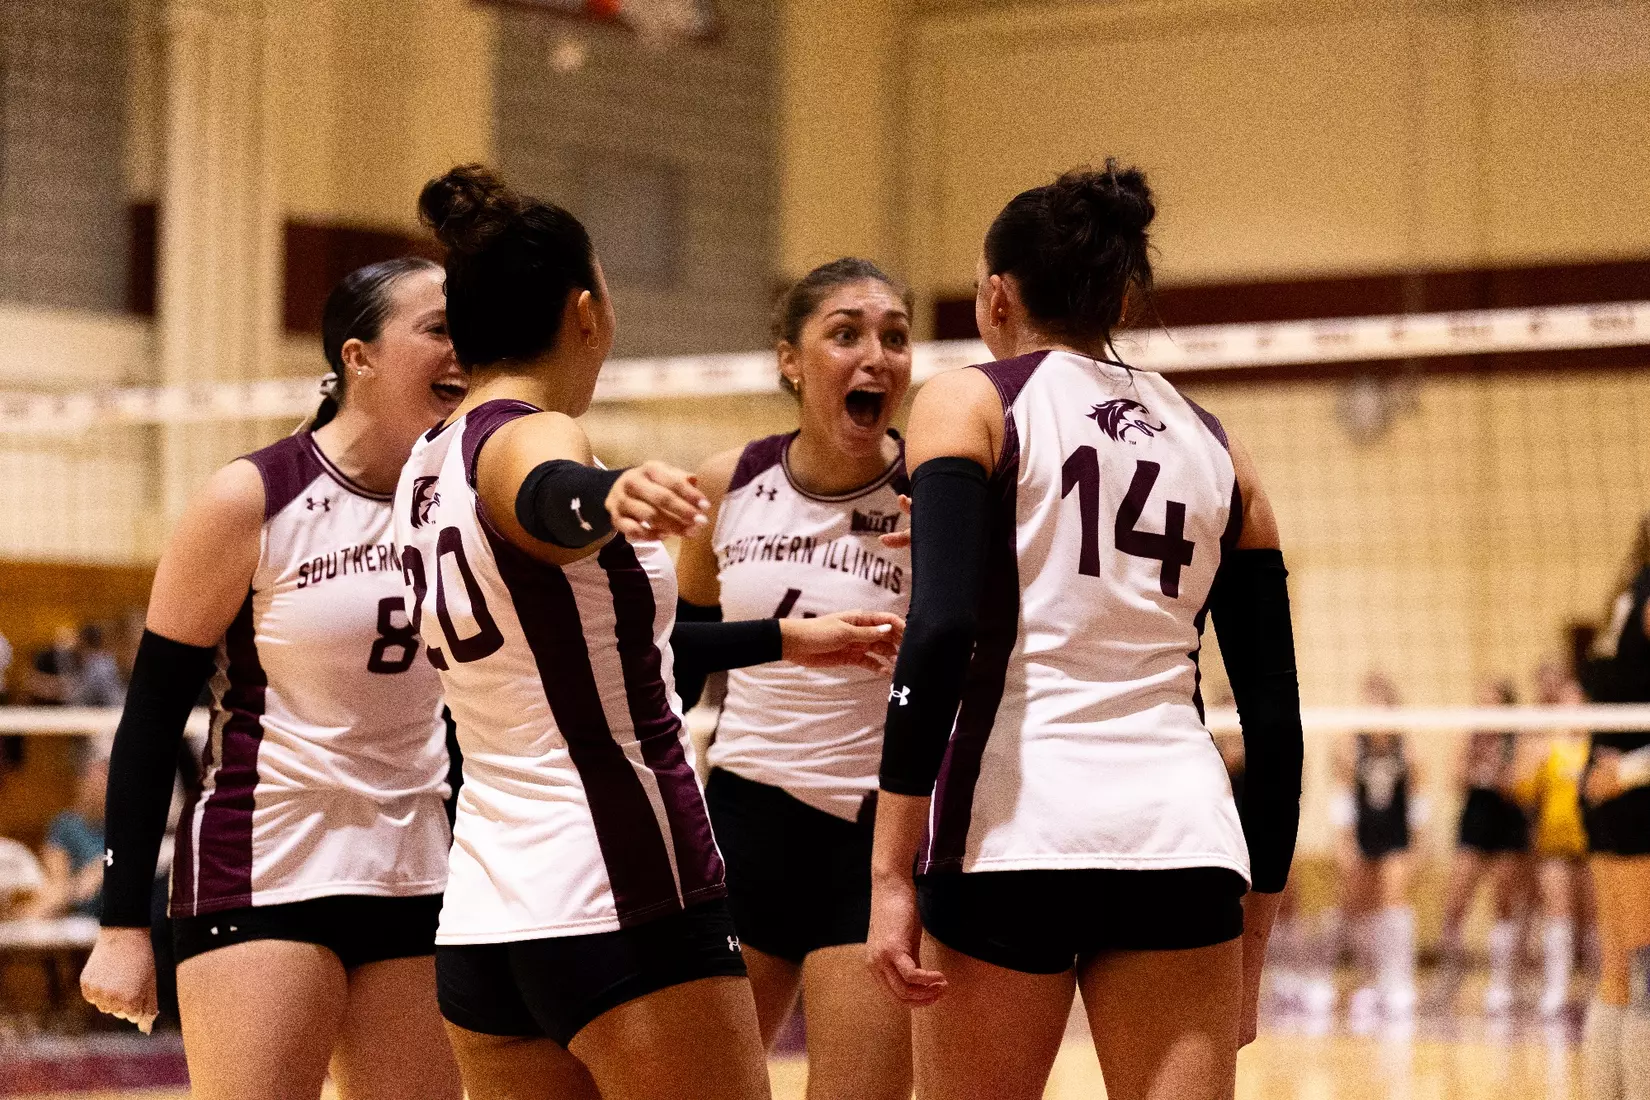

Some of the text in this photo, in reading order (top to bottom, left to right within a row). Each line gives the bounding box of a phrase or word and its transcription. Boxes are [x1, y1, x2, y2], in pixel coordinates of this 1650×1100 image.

[1061, 445, 1196, 599] 14
[296, 542, 403, 589] SOUTHERN
[402, 526, 505, 671] 20
[723, 534, 904, 594] SOUTHERN ILLINOIS
[367, 596, 420, 674] 8
